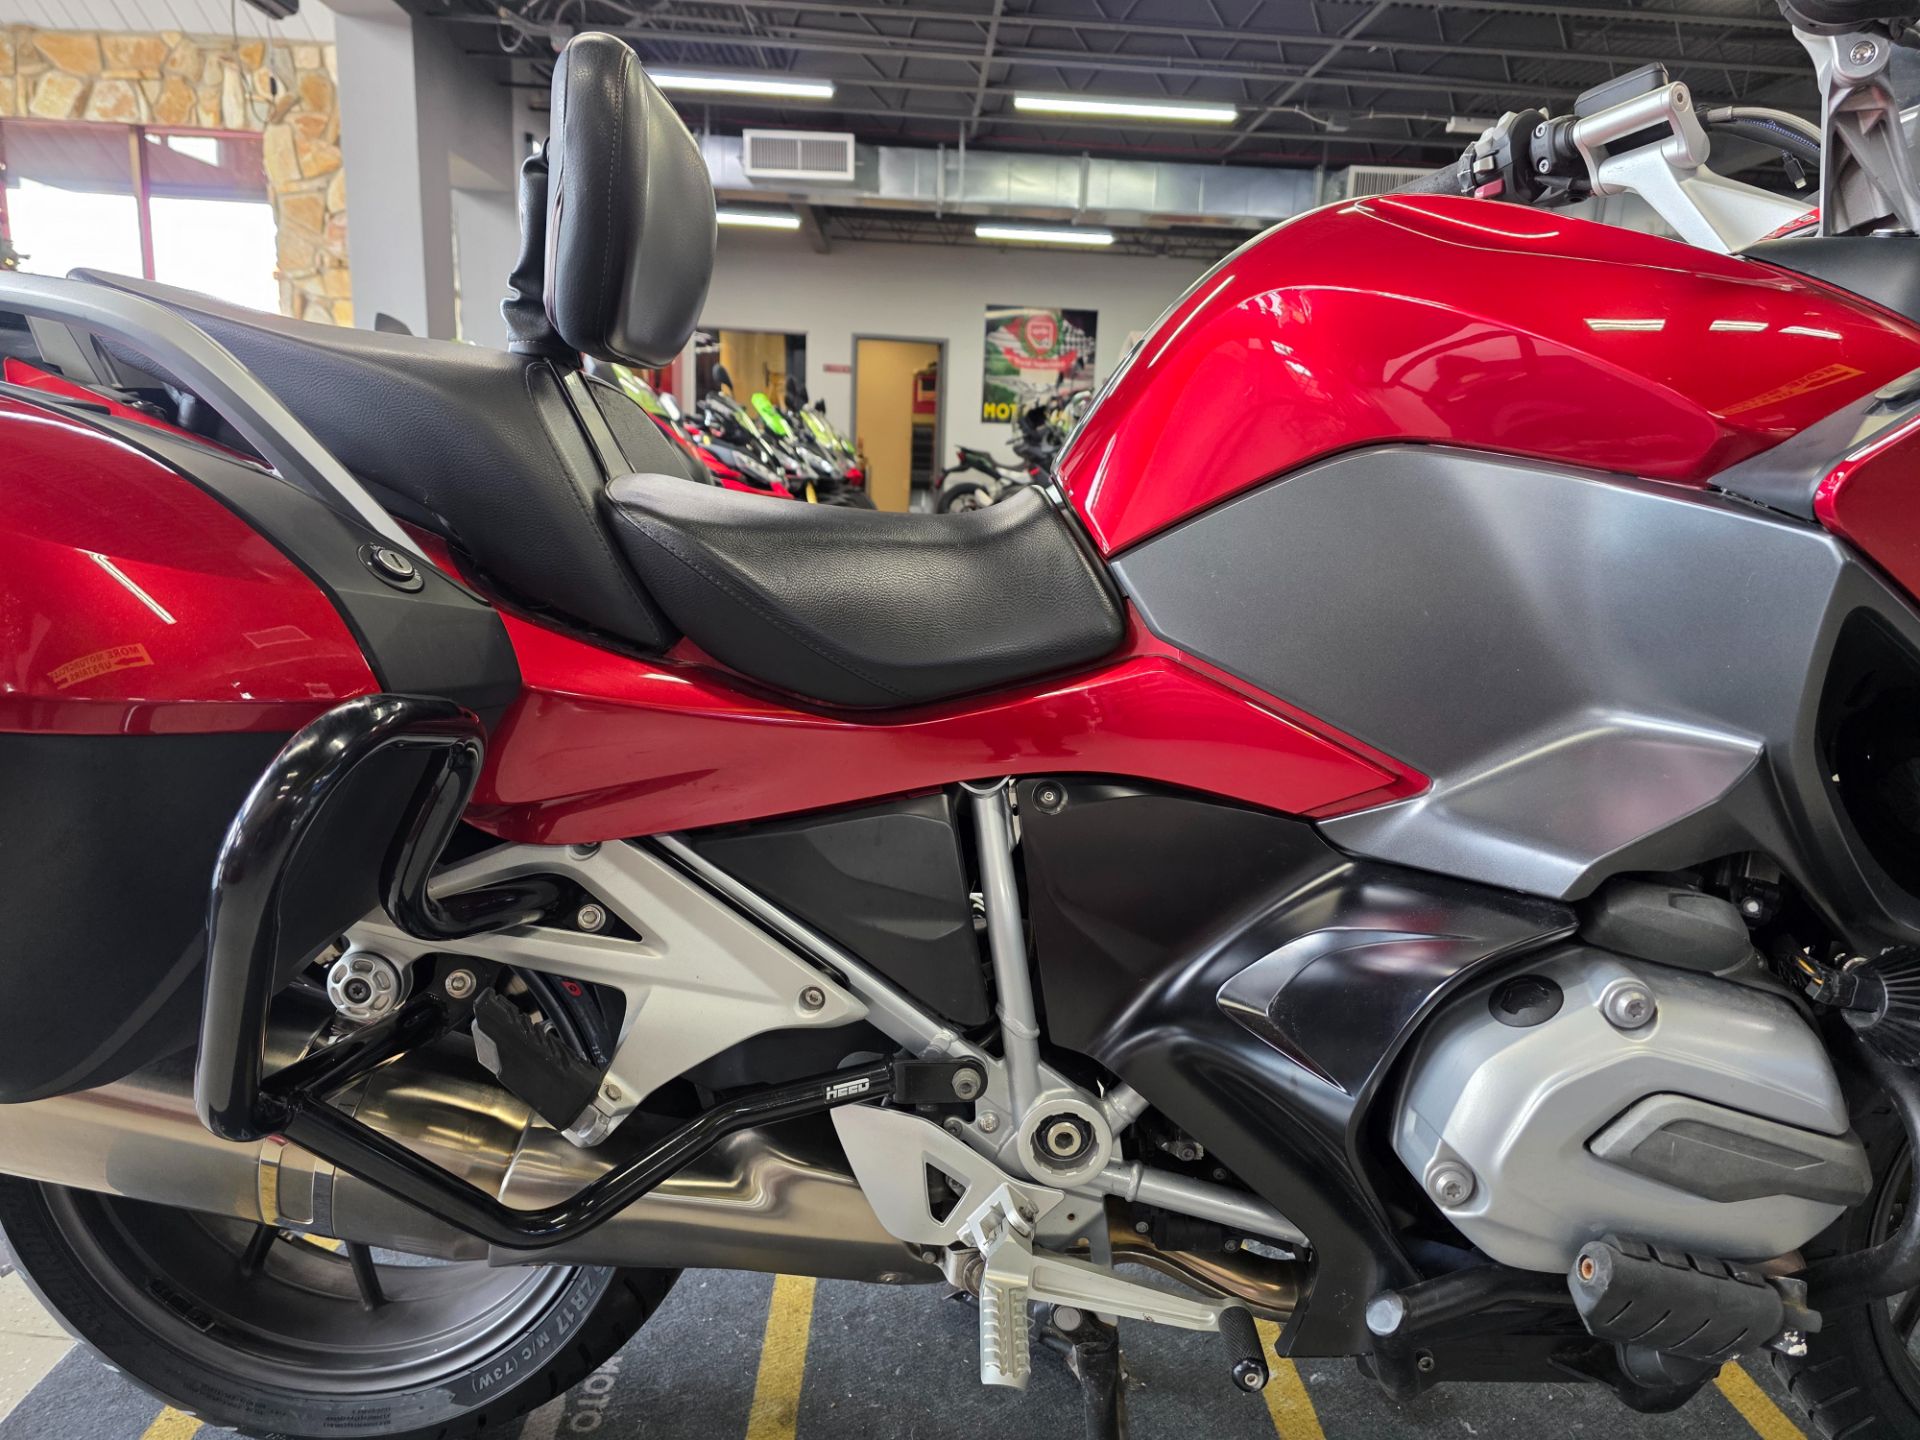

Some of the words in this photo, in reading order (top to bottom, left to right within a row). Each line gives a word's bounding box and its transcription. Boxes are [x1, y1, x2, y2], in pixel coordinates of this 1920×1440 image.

[983, 402, 1020, 420] MOT
[521, 1334, 550, 1360] M/C
[471, 1357, 519, 1393] (73W)
